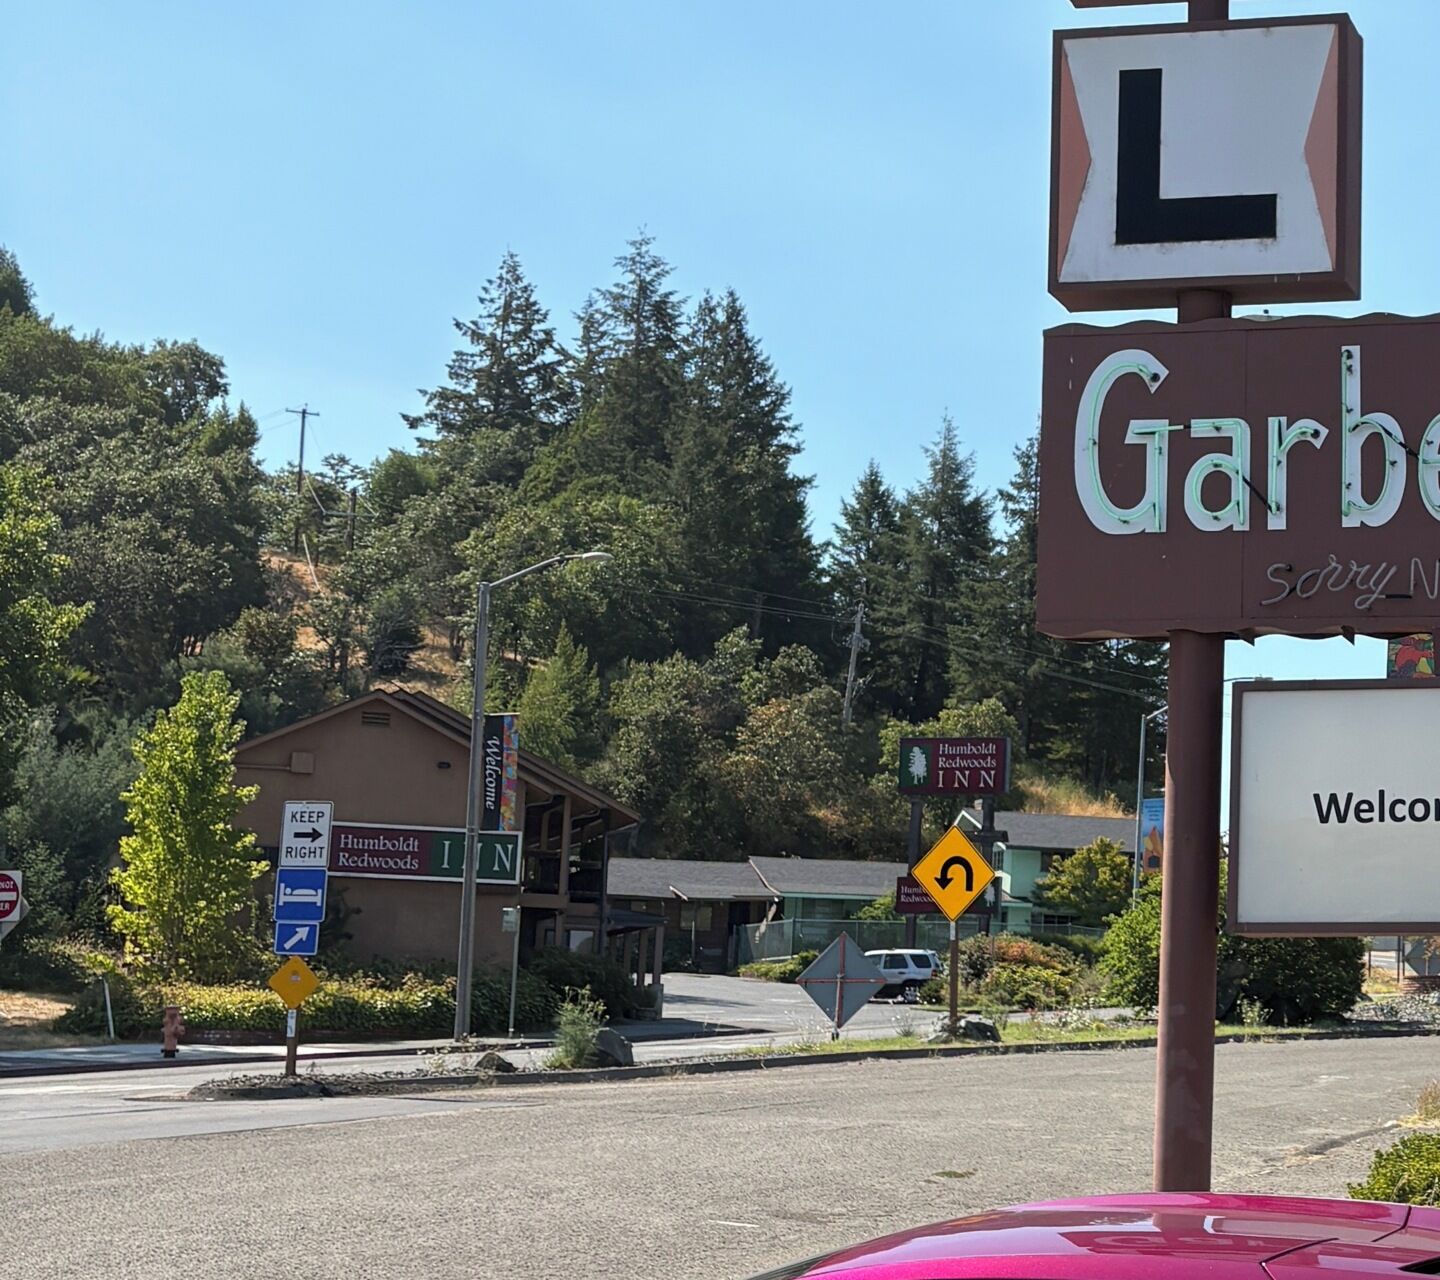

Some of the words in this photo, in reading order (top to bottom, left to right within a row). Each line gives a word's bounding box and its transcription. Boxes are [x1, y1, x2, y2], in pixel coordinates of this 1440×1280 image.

[1260, 555, 1397, 610] Sorry
[939, 742, 997, 755] Humboldt
[938, 755, 997, 768] Redwoods
[484, 735, 502, 810] Welcome
[937, 770, 996, 788] INN
[290, 810, 325, 823] KEEP
[339, 833, 419, 852] Humboldt
[285, 846, 325, 859] RIGHT
[338, 851, 419, 870] Redwoods
